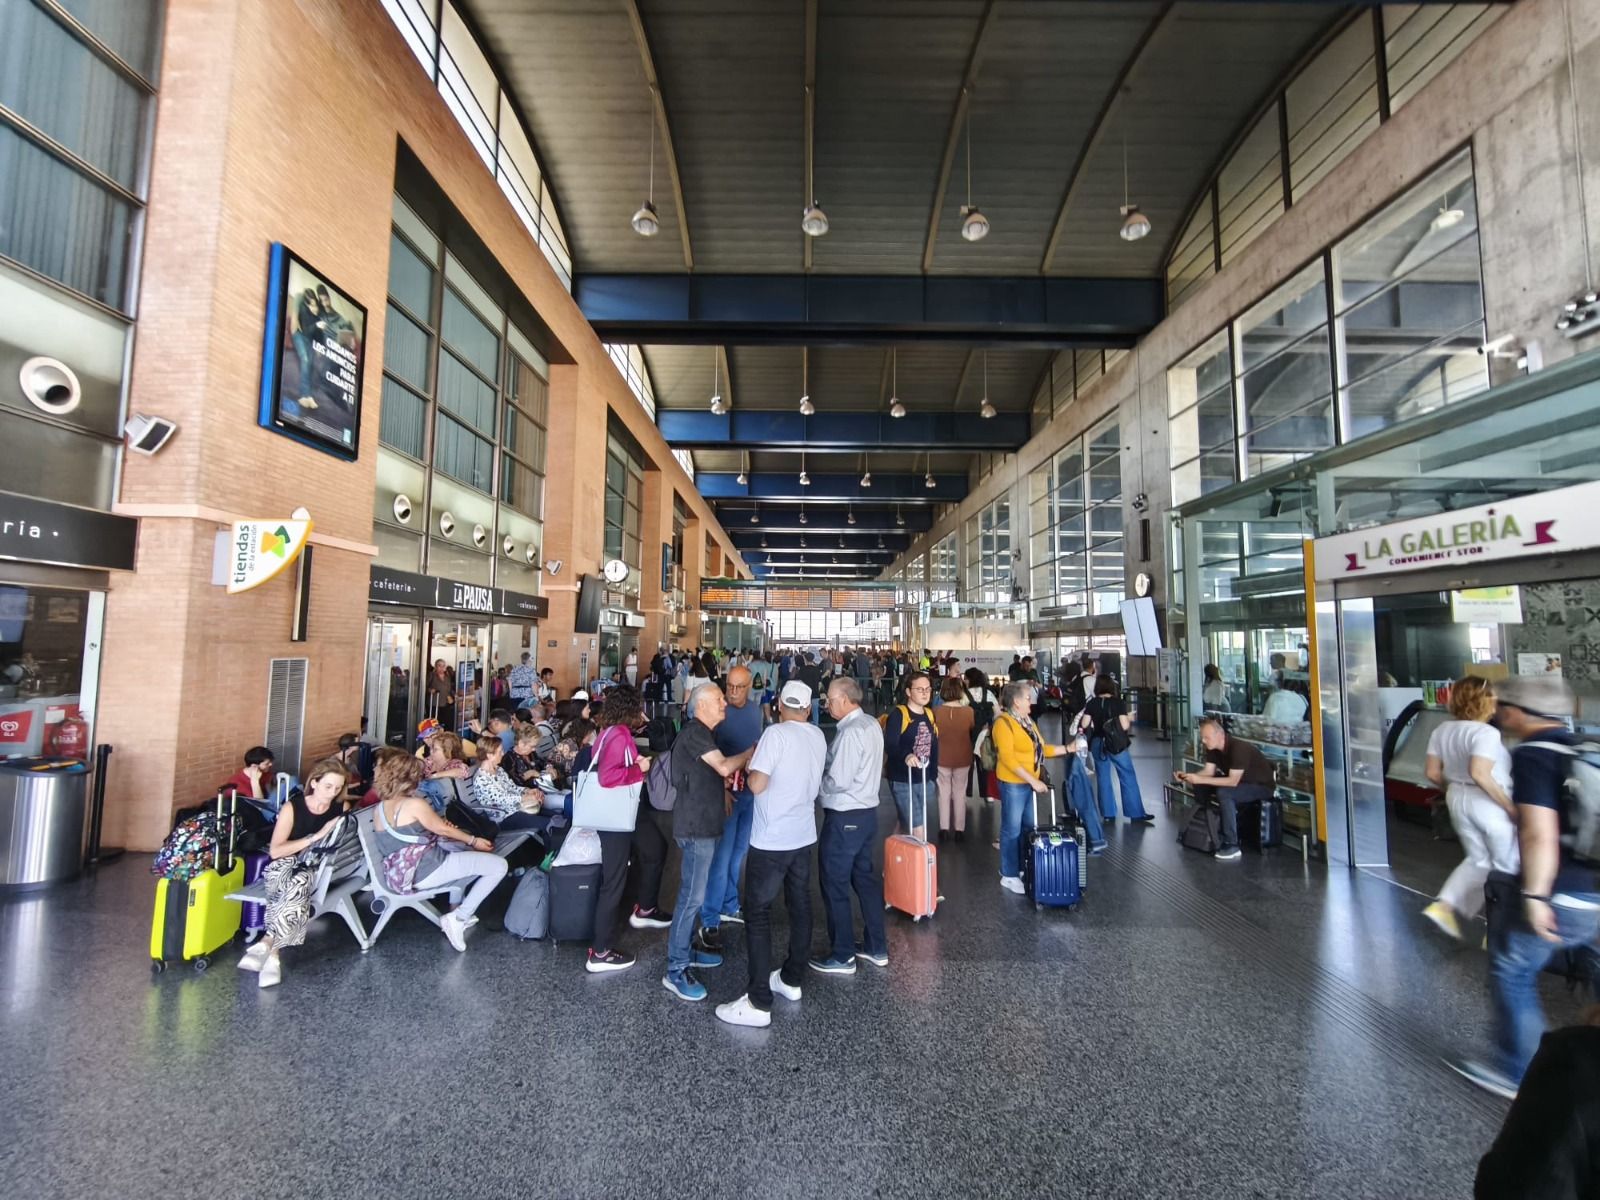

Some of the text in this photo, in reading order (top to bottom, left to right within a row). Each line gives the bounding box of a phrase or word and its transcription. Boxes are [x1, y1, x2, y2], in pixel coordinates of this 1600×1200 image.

[234, 525, 249, 584] tiendas
[1364, 538, 1393, 561] LA
[1457, 546, 1489, 556] STOR
[453, 584, 493, 612] LA PAUSA
